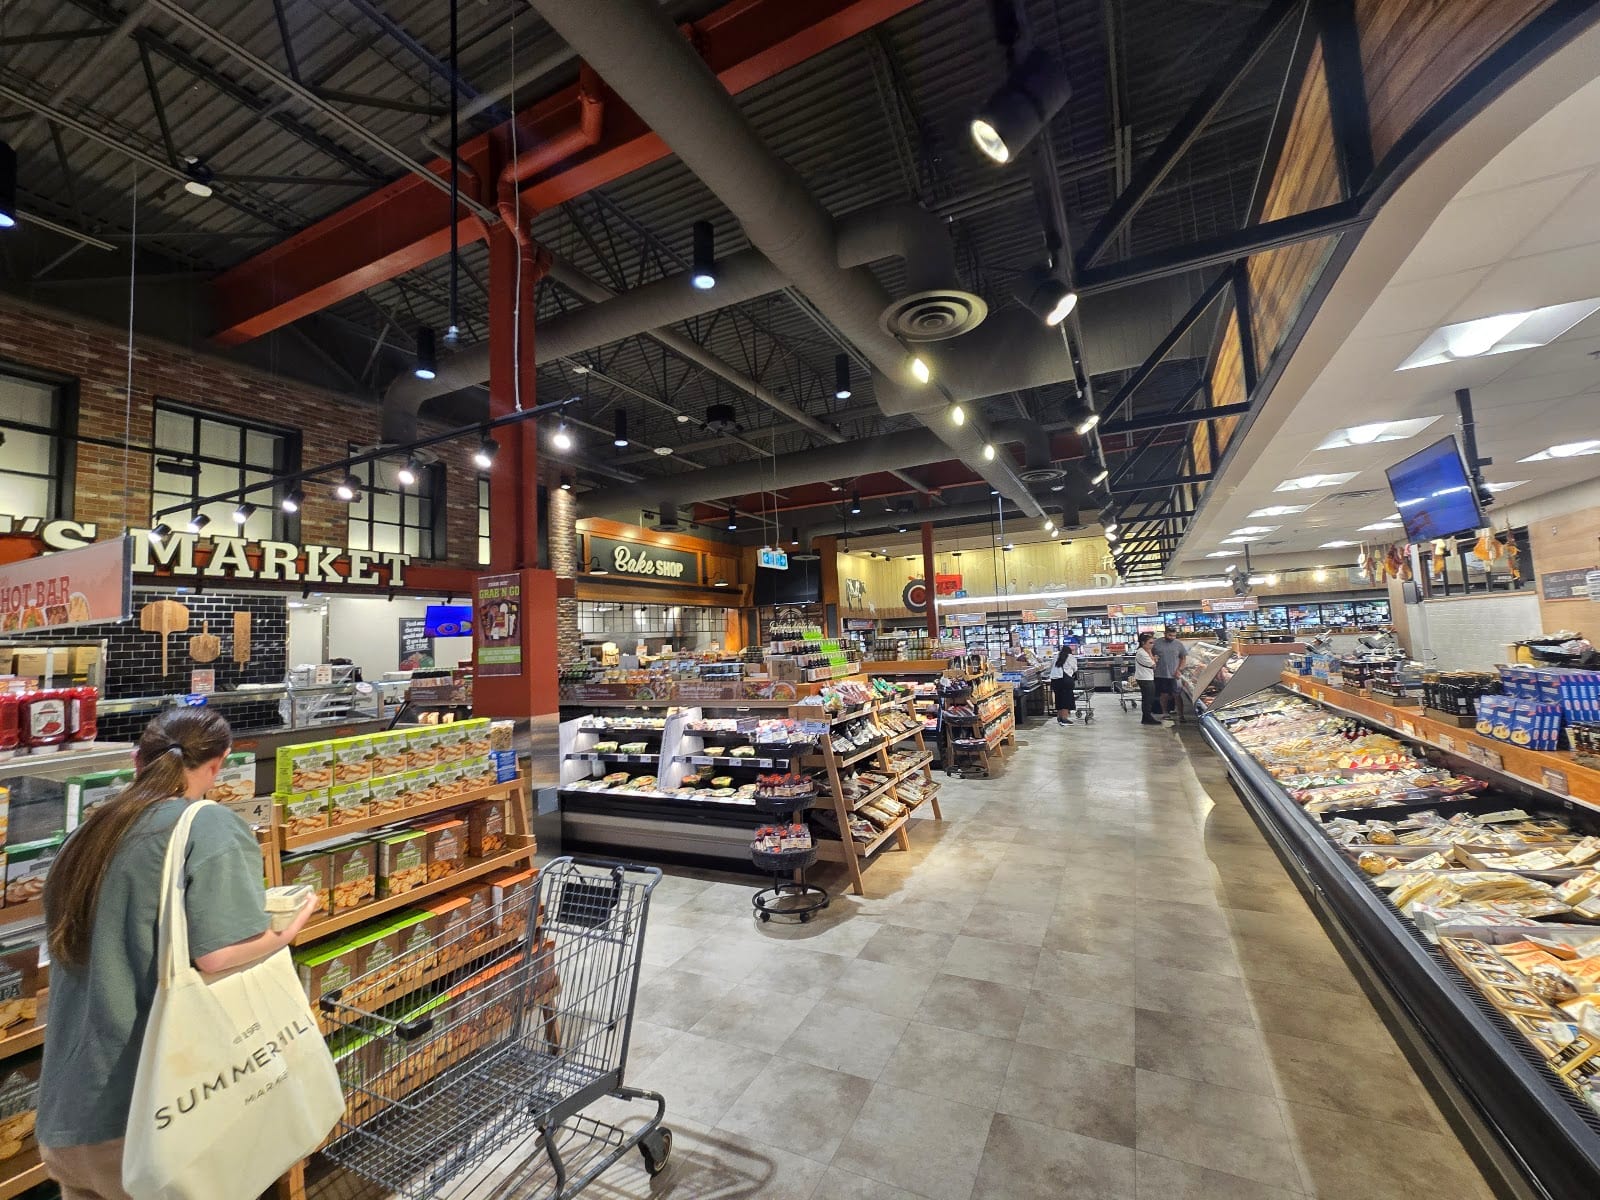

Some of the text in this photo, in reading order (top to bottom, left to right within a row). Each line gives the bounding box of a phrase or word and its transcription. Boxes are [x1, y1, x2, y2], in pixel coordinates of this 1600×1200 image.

[130, 528, 410, 587] MARKET
[614, 545, 684, 578] Bake SHOP
[0, 575, 70, 614] HOT BAR
[479, 588, 499, 599] GRAB
[509, 585, 521, 596] GO
[253, 804, 263, 817] 4
